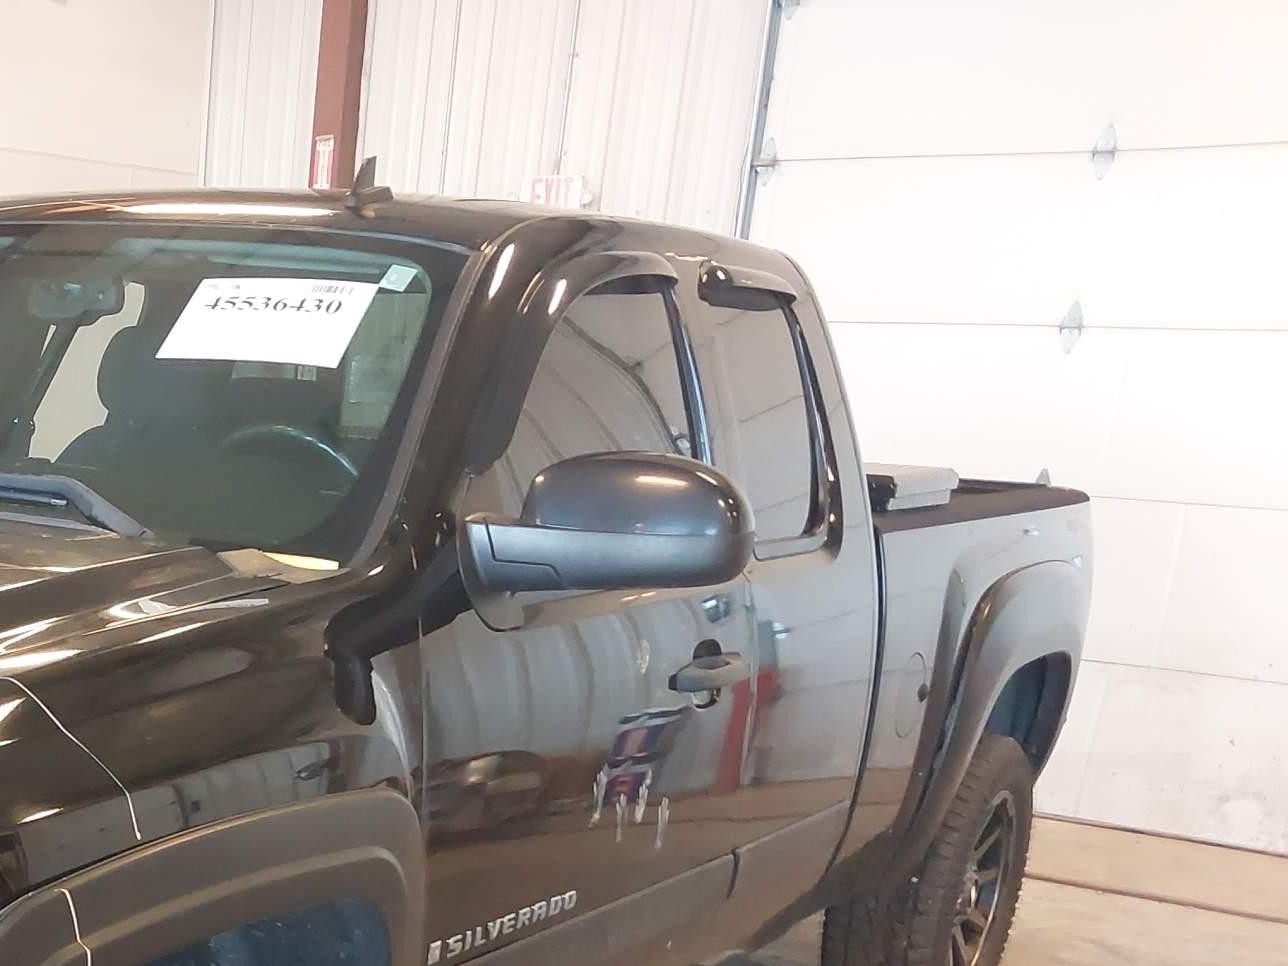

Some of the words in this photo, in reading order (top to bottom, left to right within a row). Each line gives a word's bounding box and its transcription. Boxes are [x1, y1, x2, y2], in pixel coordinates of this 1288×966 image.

[531, 177, 574, 208] EXIT
[204, 296, 343, 315] 45536430
[446, 890, 577, 959] SILVERADO
